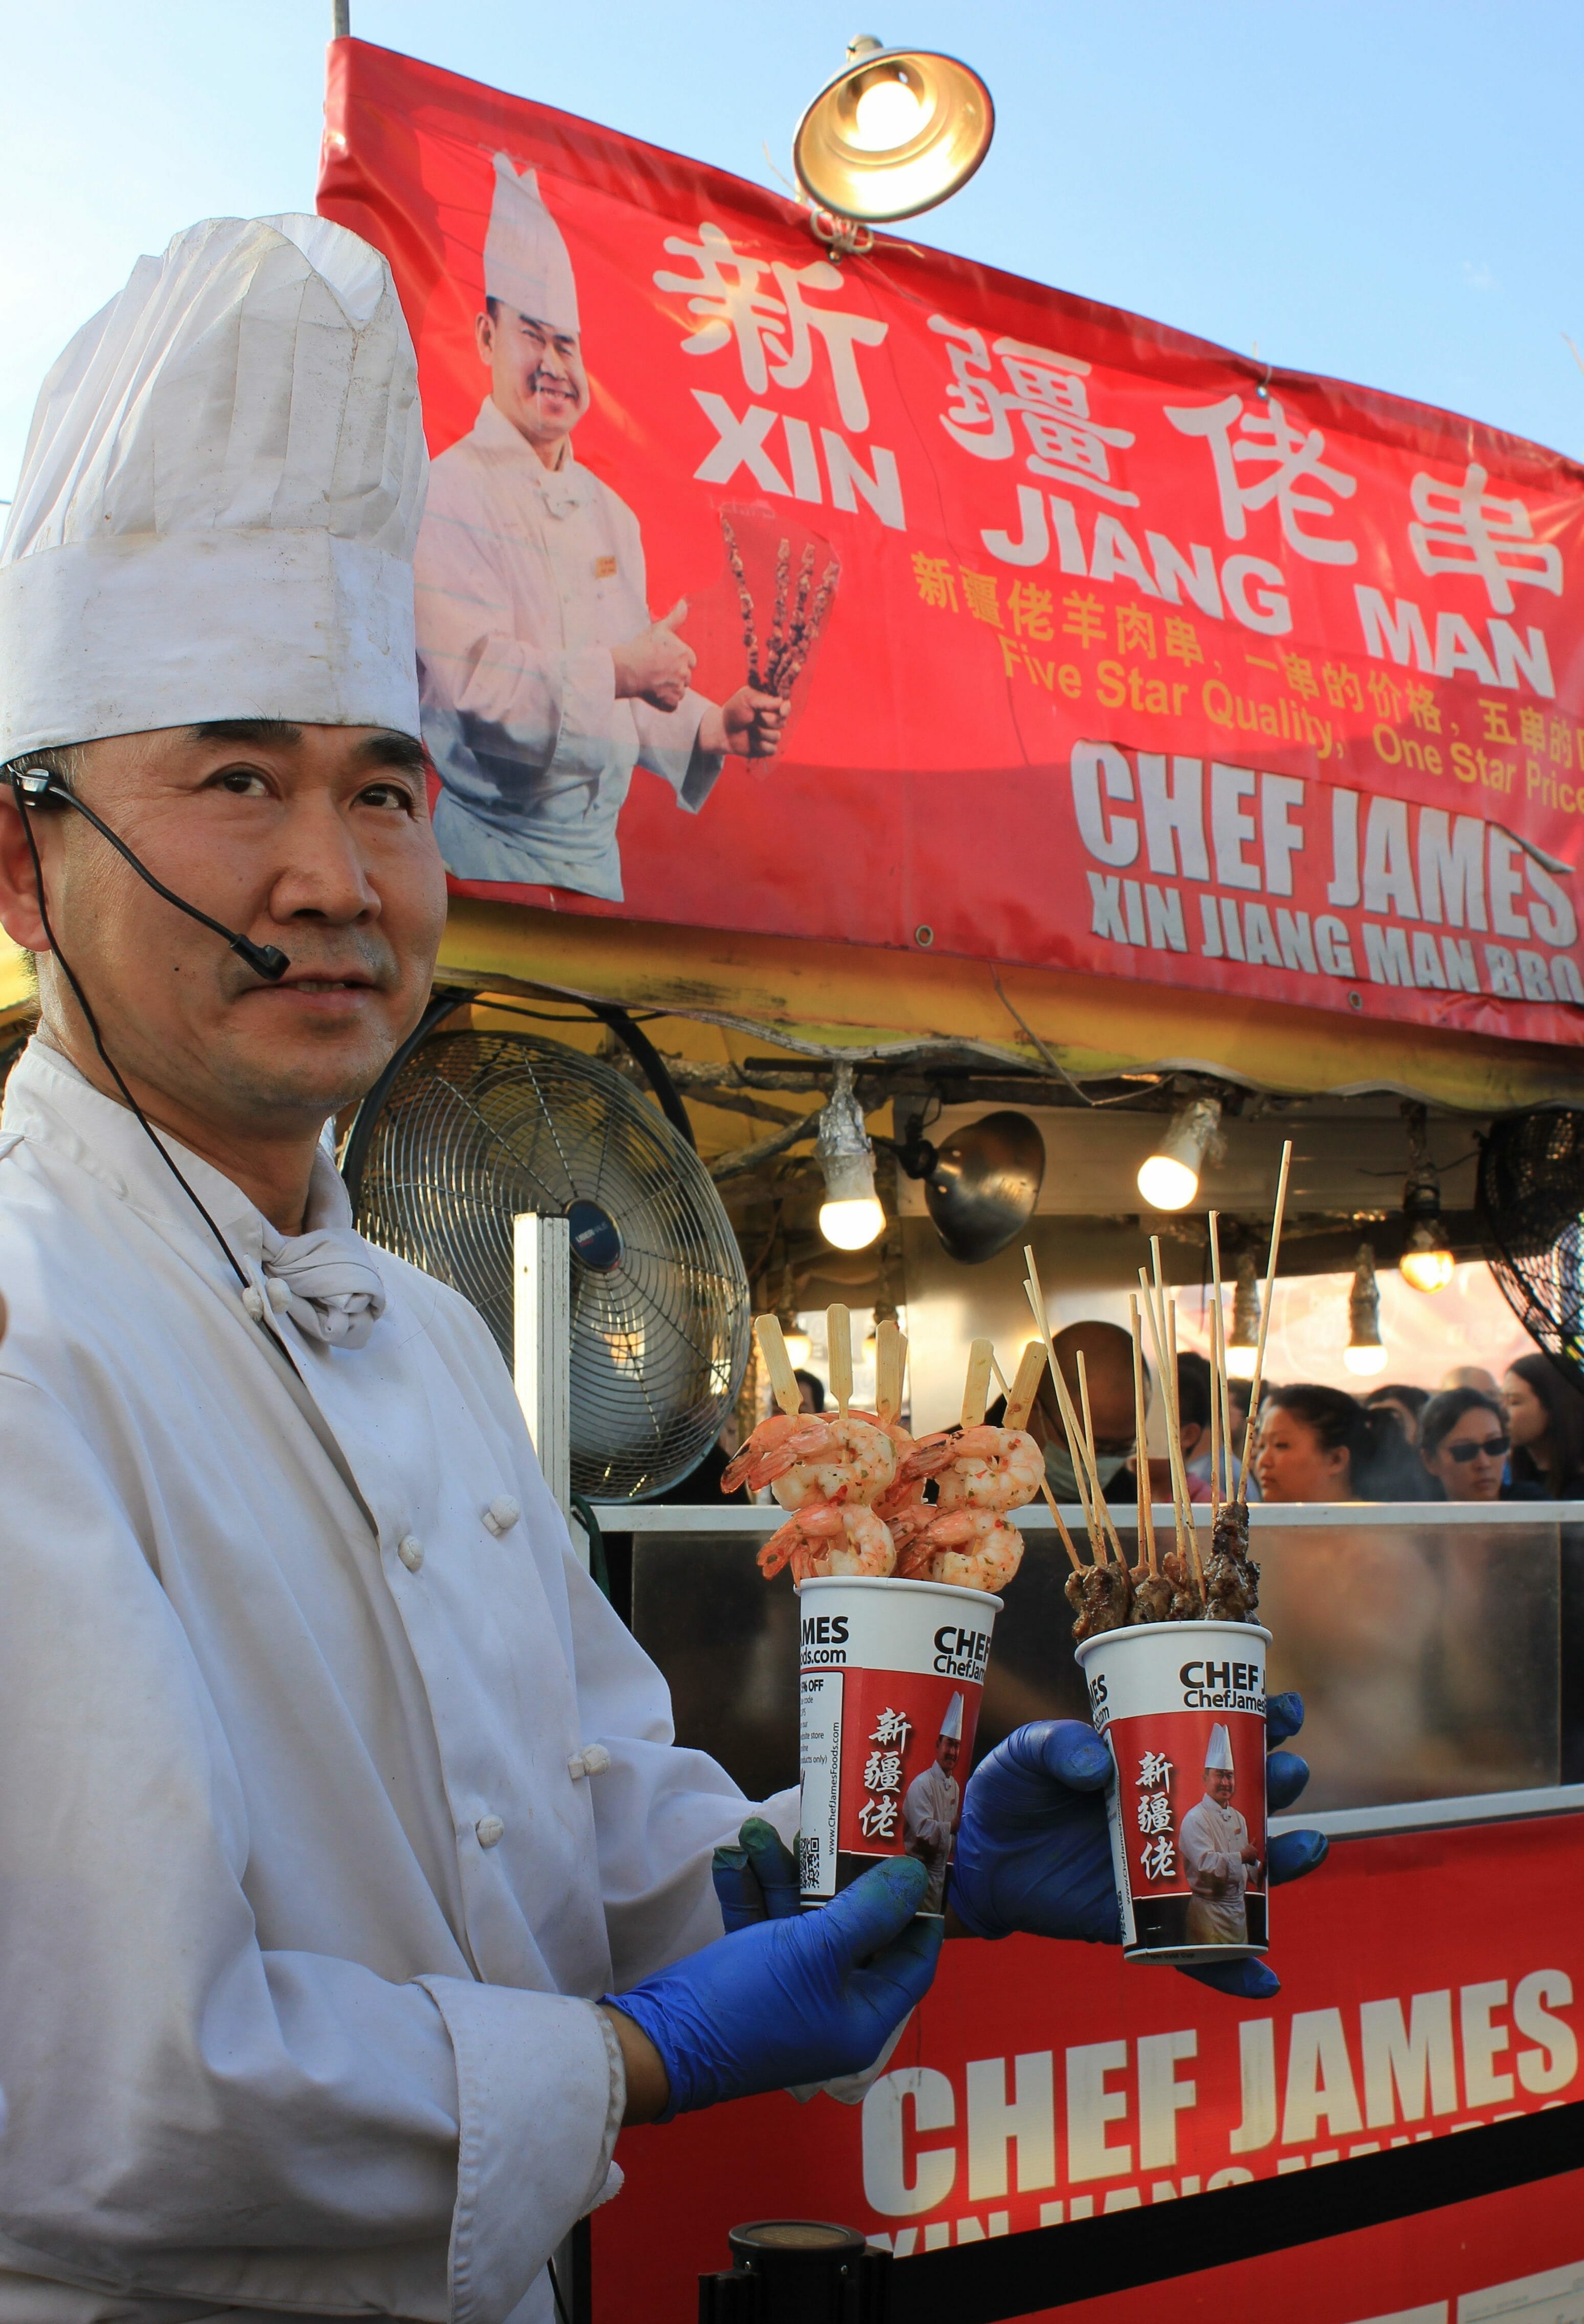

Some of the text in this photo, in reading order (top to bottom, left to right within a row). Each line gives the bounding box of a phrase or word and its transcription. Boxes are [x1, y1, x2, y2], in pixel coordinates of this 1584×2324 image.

[690, 388, 1555, 699] XIN JIANG MAN
[997, 634, 1082, 700] Five
[1096, 660, 1190, 717] Star
[1202, 679, 1345, 759] Quality,
[1373, 723, 1443, 775] One
[1449, 742, 1517, 794] Star
[1069, 738, 1577, 948] CHEF JAMES
[1086, 870, 1188, 953] XIN
[1200, 893, 1357, 978] JIANG
[1362, 922, 1481, 994] MAN
[801, 1616, 849, 1647] MES
[809, 1679, 824, 1692] OFF
[934, 1626, 991, 1663] CHEF
[1180, 1661, 1258, 1691] CHEF
[813, 1755, 827, 1765] only)
[828, 1722, 840, 1856] www.ChefJamesFoods.com
[859, 1706, 912, 1837] 新疆佬
[1135, 1750, 1176, 1881] 新疆佬
[861, 2029, 1198, 2217] CHEF
[1230, 1968, 1578, 2154] JAMES
